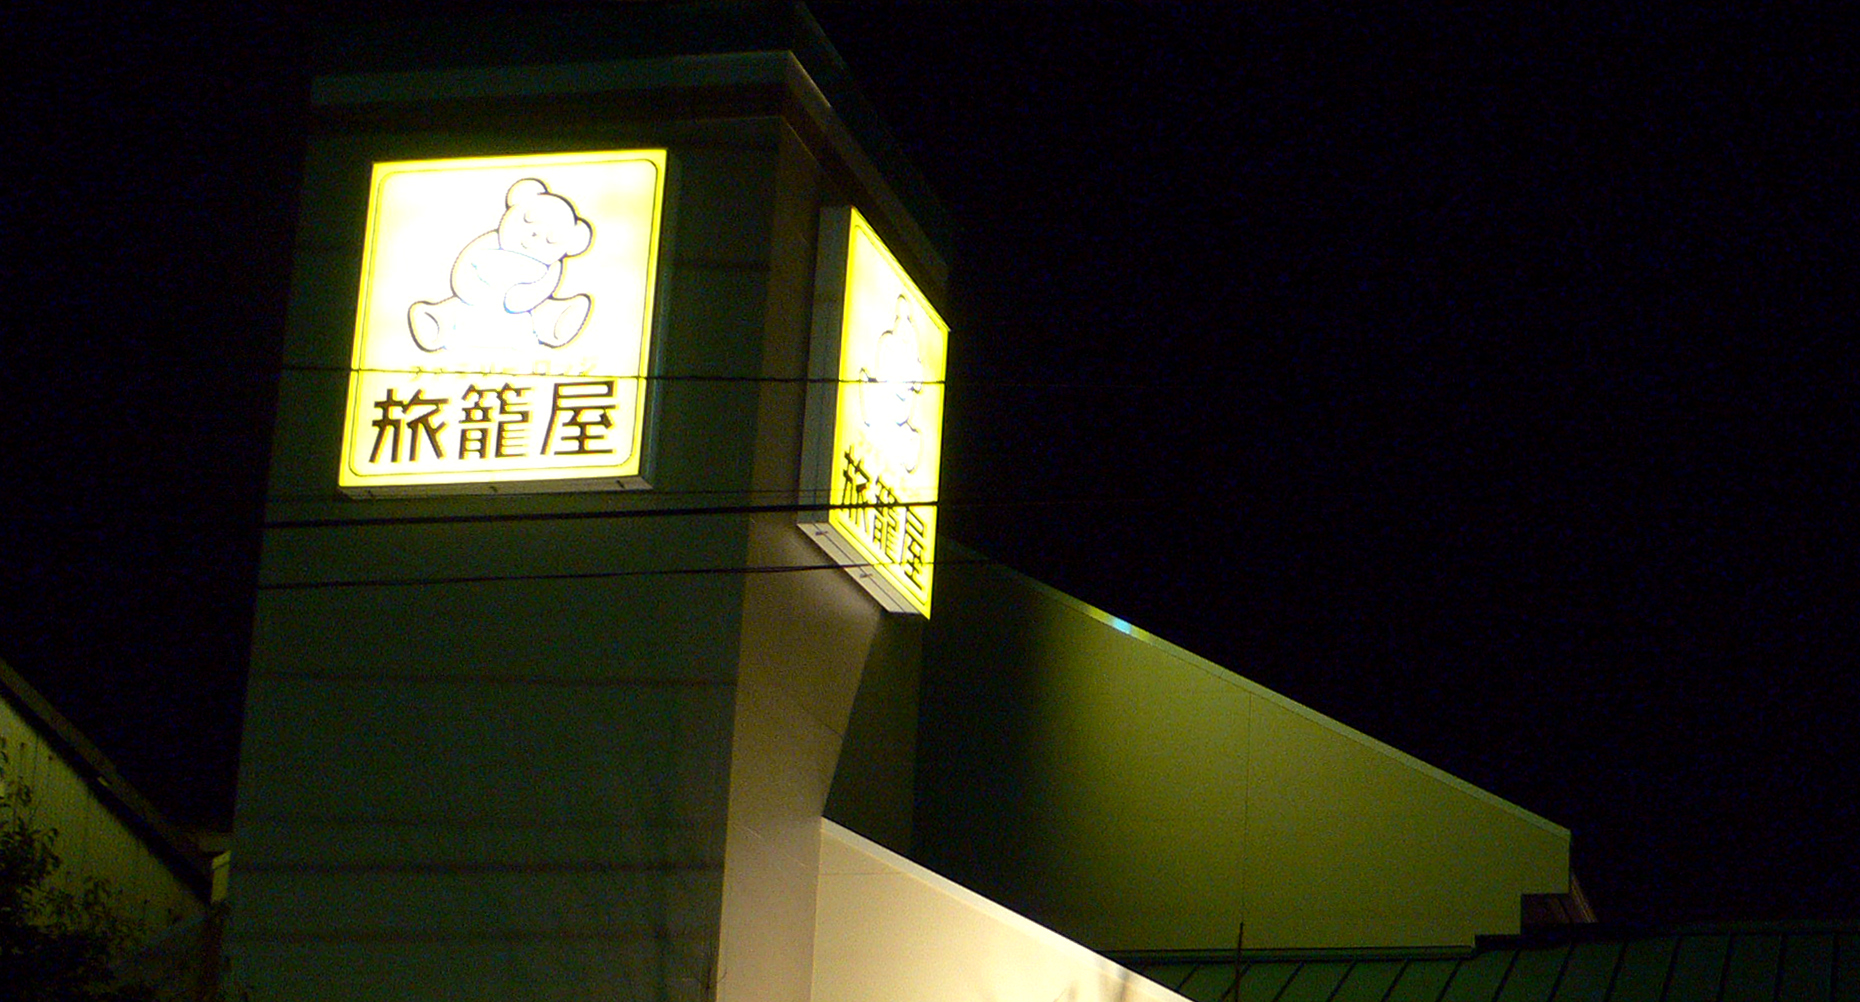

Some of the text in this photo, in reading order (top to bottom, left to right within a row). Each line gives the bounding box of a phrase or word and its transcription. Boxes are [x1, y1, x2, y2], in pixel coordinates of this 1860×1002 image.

[369, 380, 617, 463] 旅籠屋
[842, 446, 924, 591] 旅籠屋
